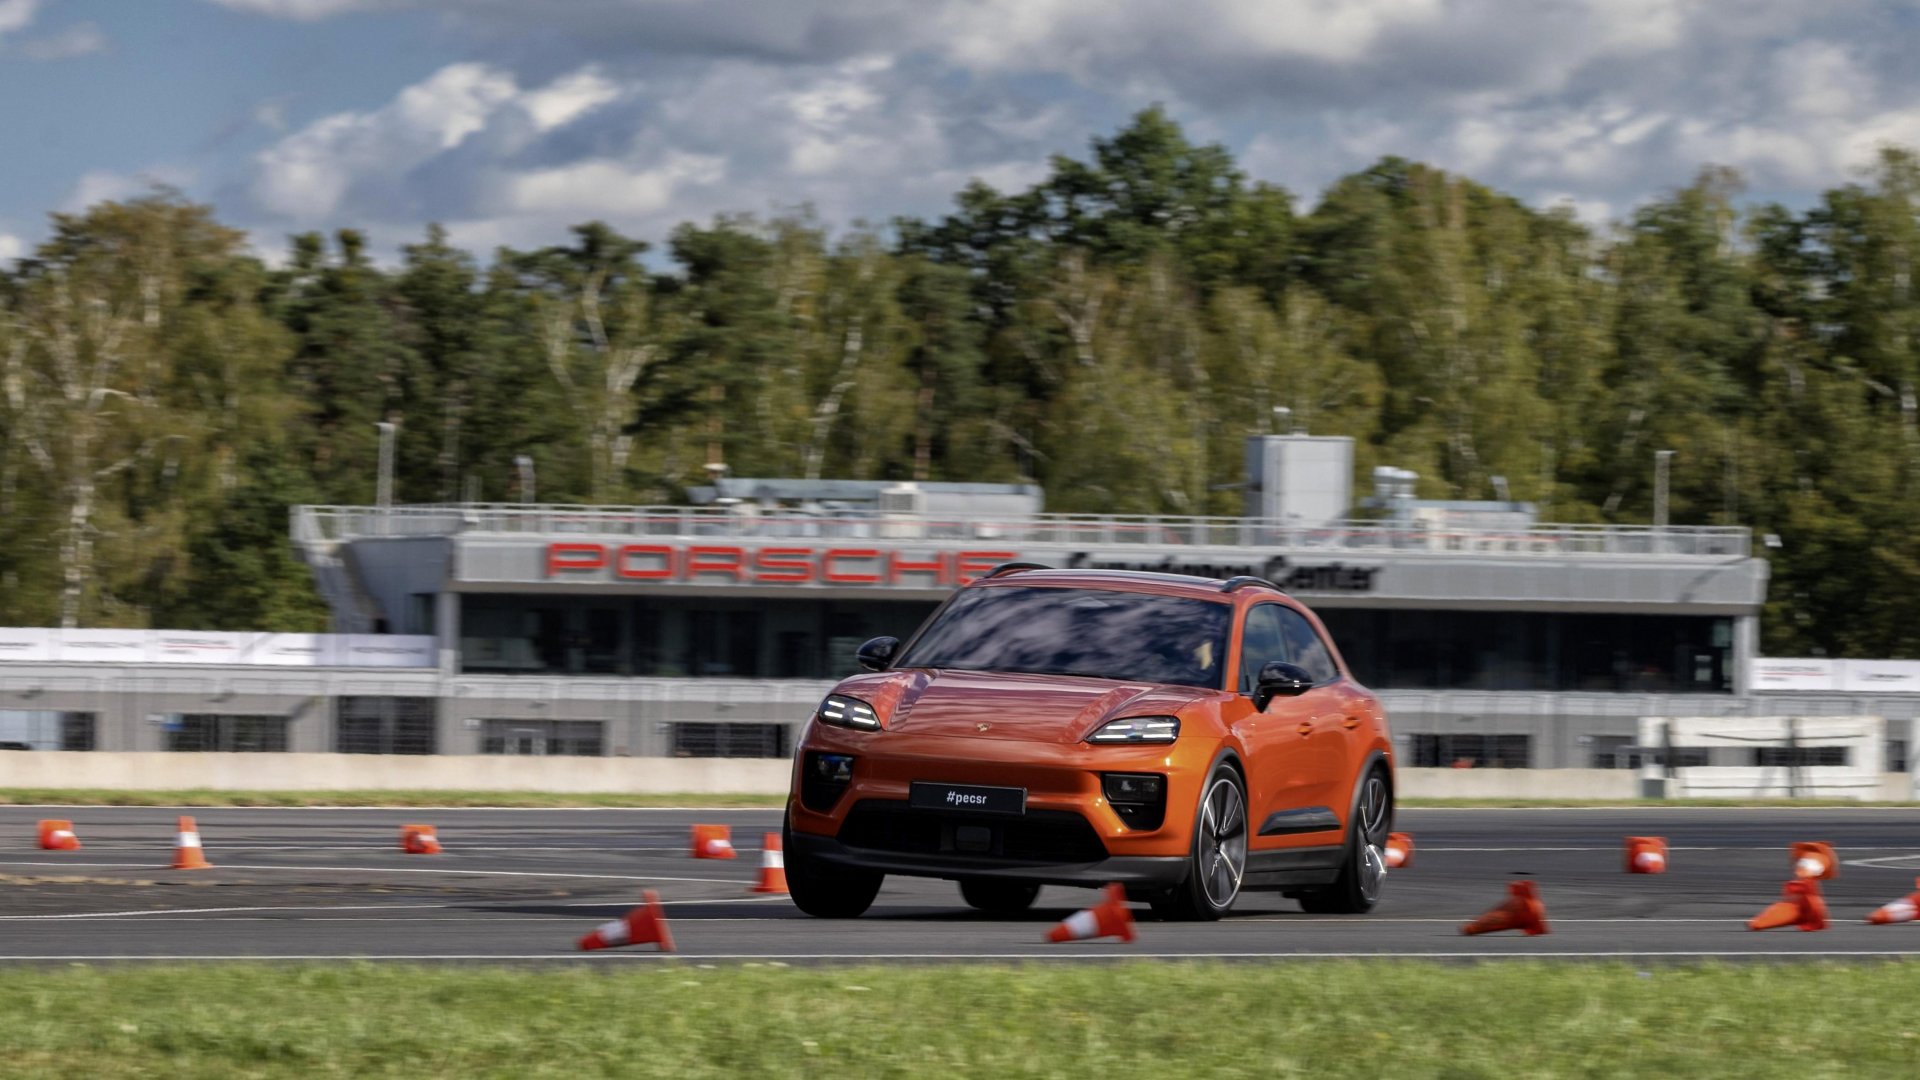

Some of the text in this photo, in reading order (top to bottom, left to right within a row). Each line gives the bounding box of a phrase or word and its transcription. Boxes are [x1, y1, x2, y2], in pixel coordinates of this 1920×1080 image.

[547, 543, 1018, 585] PORSCHE
[1264, 555, 1381, 591] Center
[946, 791, 987, 805] #pecsr
